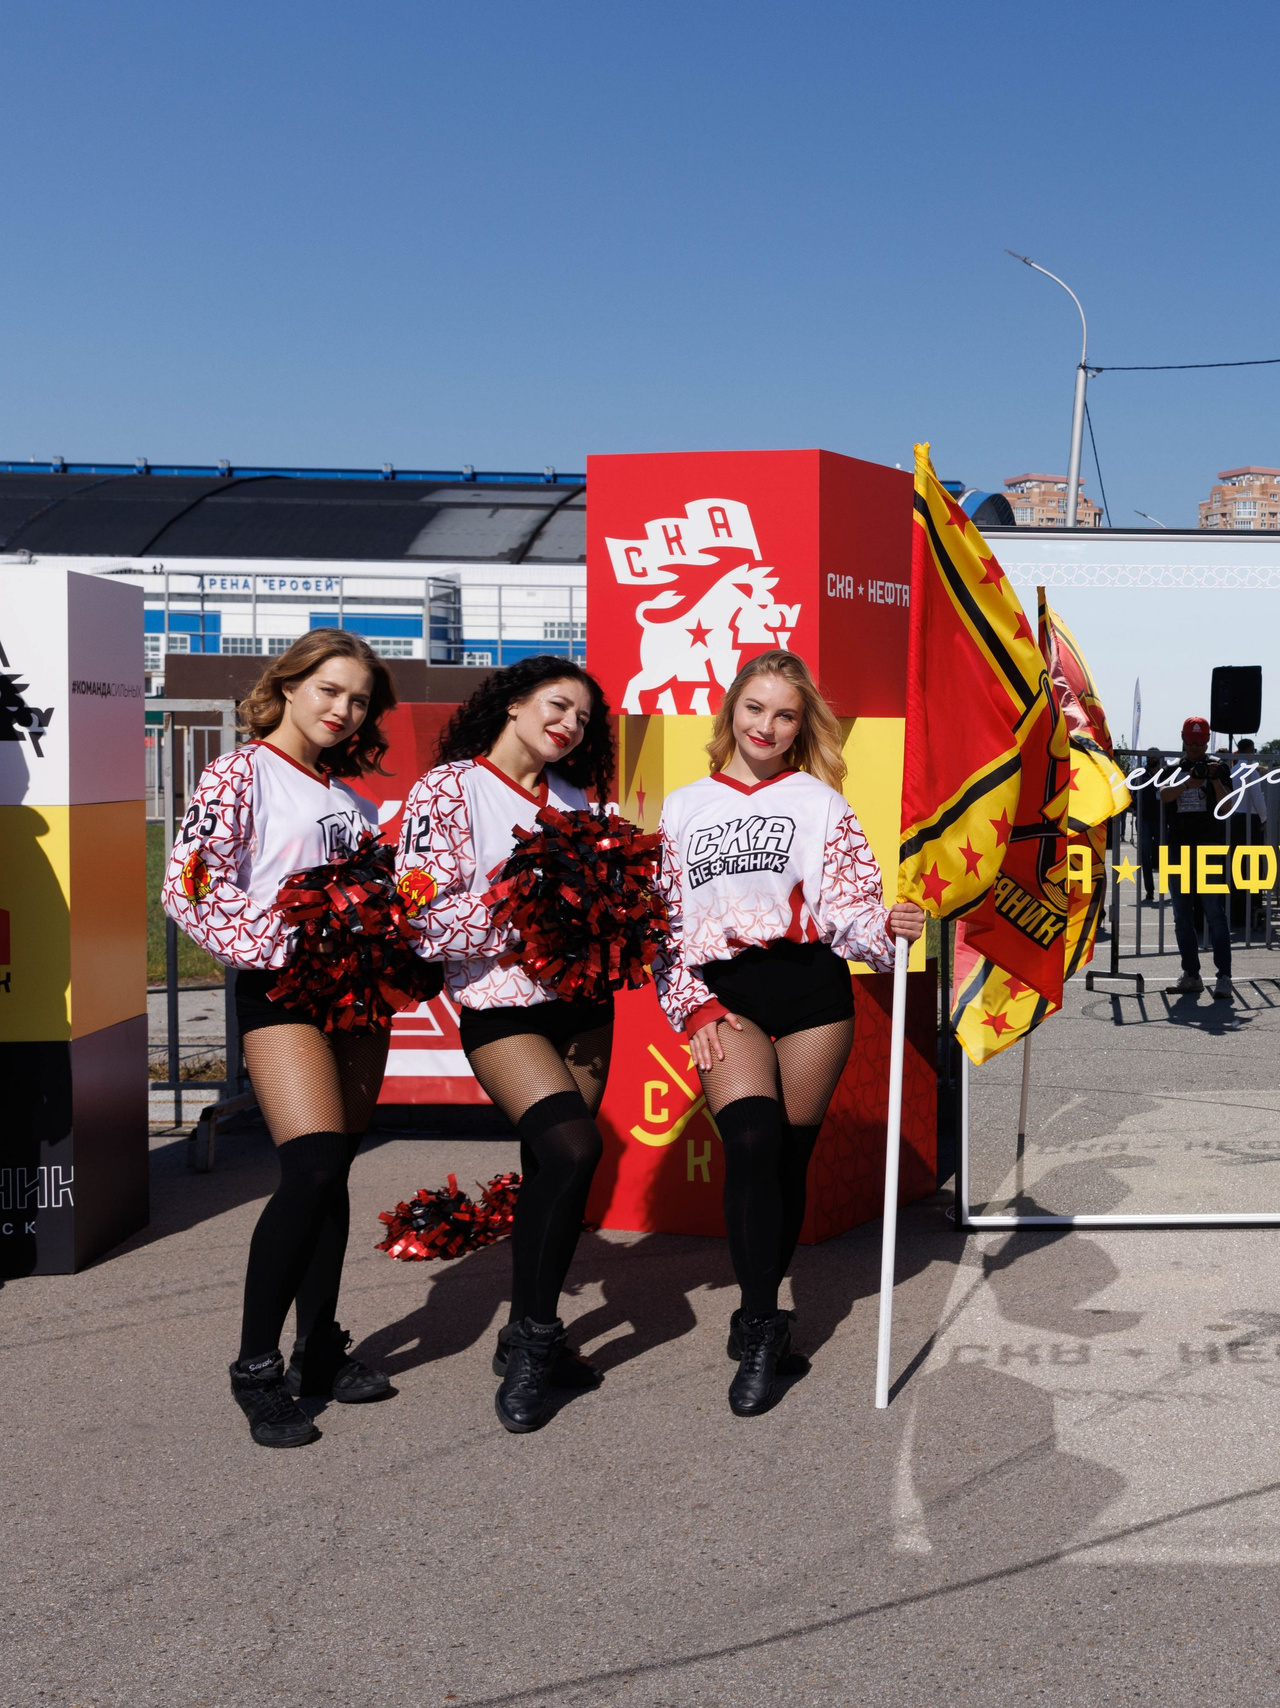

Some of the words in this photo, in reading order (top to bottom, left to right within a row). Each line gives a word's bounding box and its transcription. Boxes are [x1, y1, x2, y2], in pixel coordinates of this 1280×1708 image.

[624, 506, 733, 578] СКА
[263, 577, 340, 591] "ЕРОФЕЙ"
[827, 573, 854, 599] СКА
[868, 579, 910, 607] НЕФТЯ
[72, 680, 142, 699] #КОМАНДАСИЛЬНЫХ
[1109, 757, 1191, 791] ей
[183, 799, 221, 845] 25
[317, 810, 374, 862] СК
[405, 815, 431, 854] 12
[687, 815, 796, 866] СКА
[689, 853, 789, 889] НЕФТЯНИК
[402, 881, 426, 907] СКА
[995, 873, 1066, 946] ЯНИК
